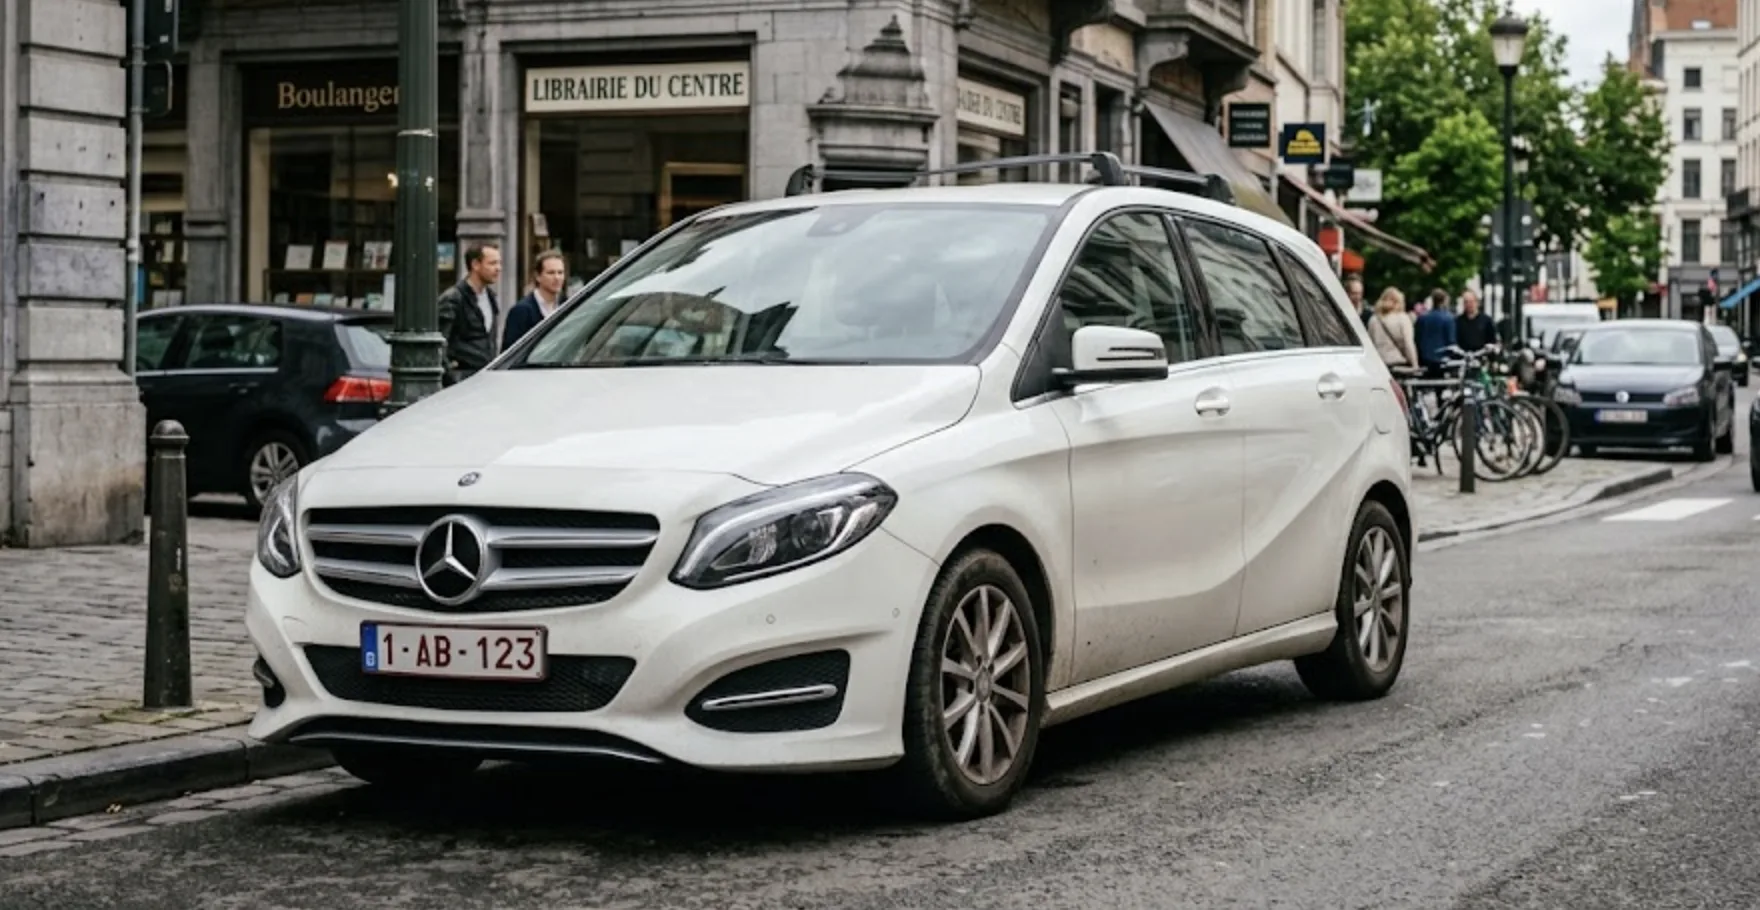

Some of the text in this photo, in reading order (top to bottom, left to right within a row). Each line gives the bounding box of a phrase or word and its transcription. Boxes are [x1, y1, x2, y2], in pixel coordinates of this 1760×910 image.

[533, 72, 744, 101] LIBRAIRIE DU CENTRE
